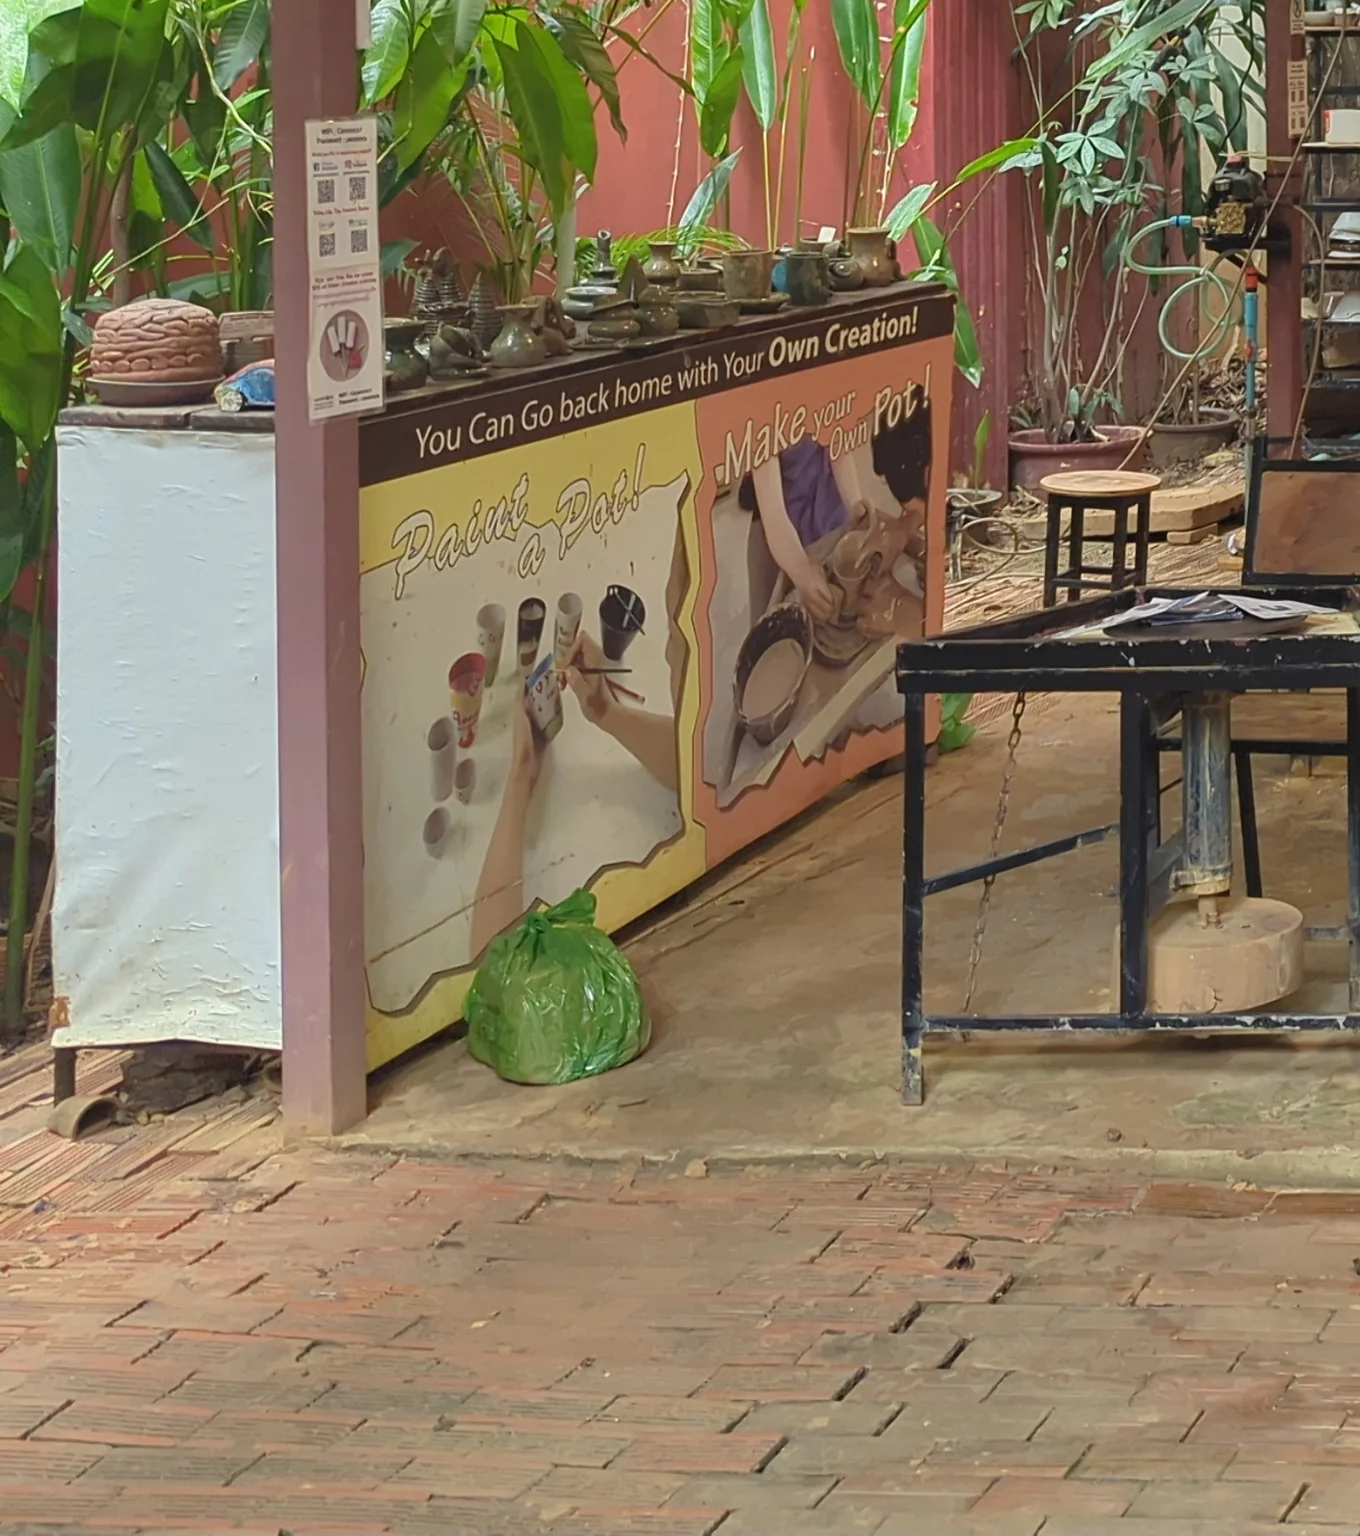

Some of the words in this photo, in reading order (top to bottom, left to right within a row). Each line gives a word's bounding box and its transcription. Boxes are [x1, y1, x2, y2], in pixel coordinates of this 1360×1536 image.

[415, 425, 461, 459] You
[468, 412, 514, 445] Can
[521, 399, 553, 431] Go
[559, 382, 610, 422] back
[614, 376, 672, 408] home
[677, 356, 719, 392] with
[723, 351, 764, 380] Your
[768, 335, 819, 368] Own
[824, 306, 920, 354] Creation!
[812, 389, 857, 442] your
[724, 401, 807, 485] Make
[829, 420, 869, 462] Own
[391, 472, 530, 601] Paint
[518, 532, 547, 579] a
[555, 443, 647, 561] Pot!
